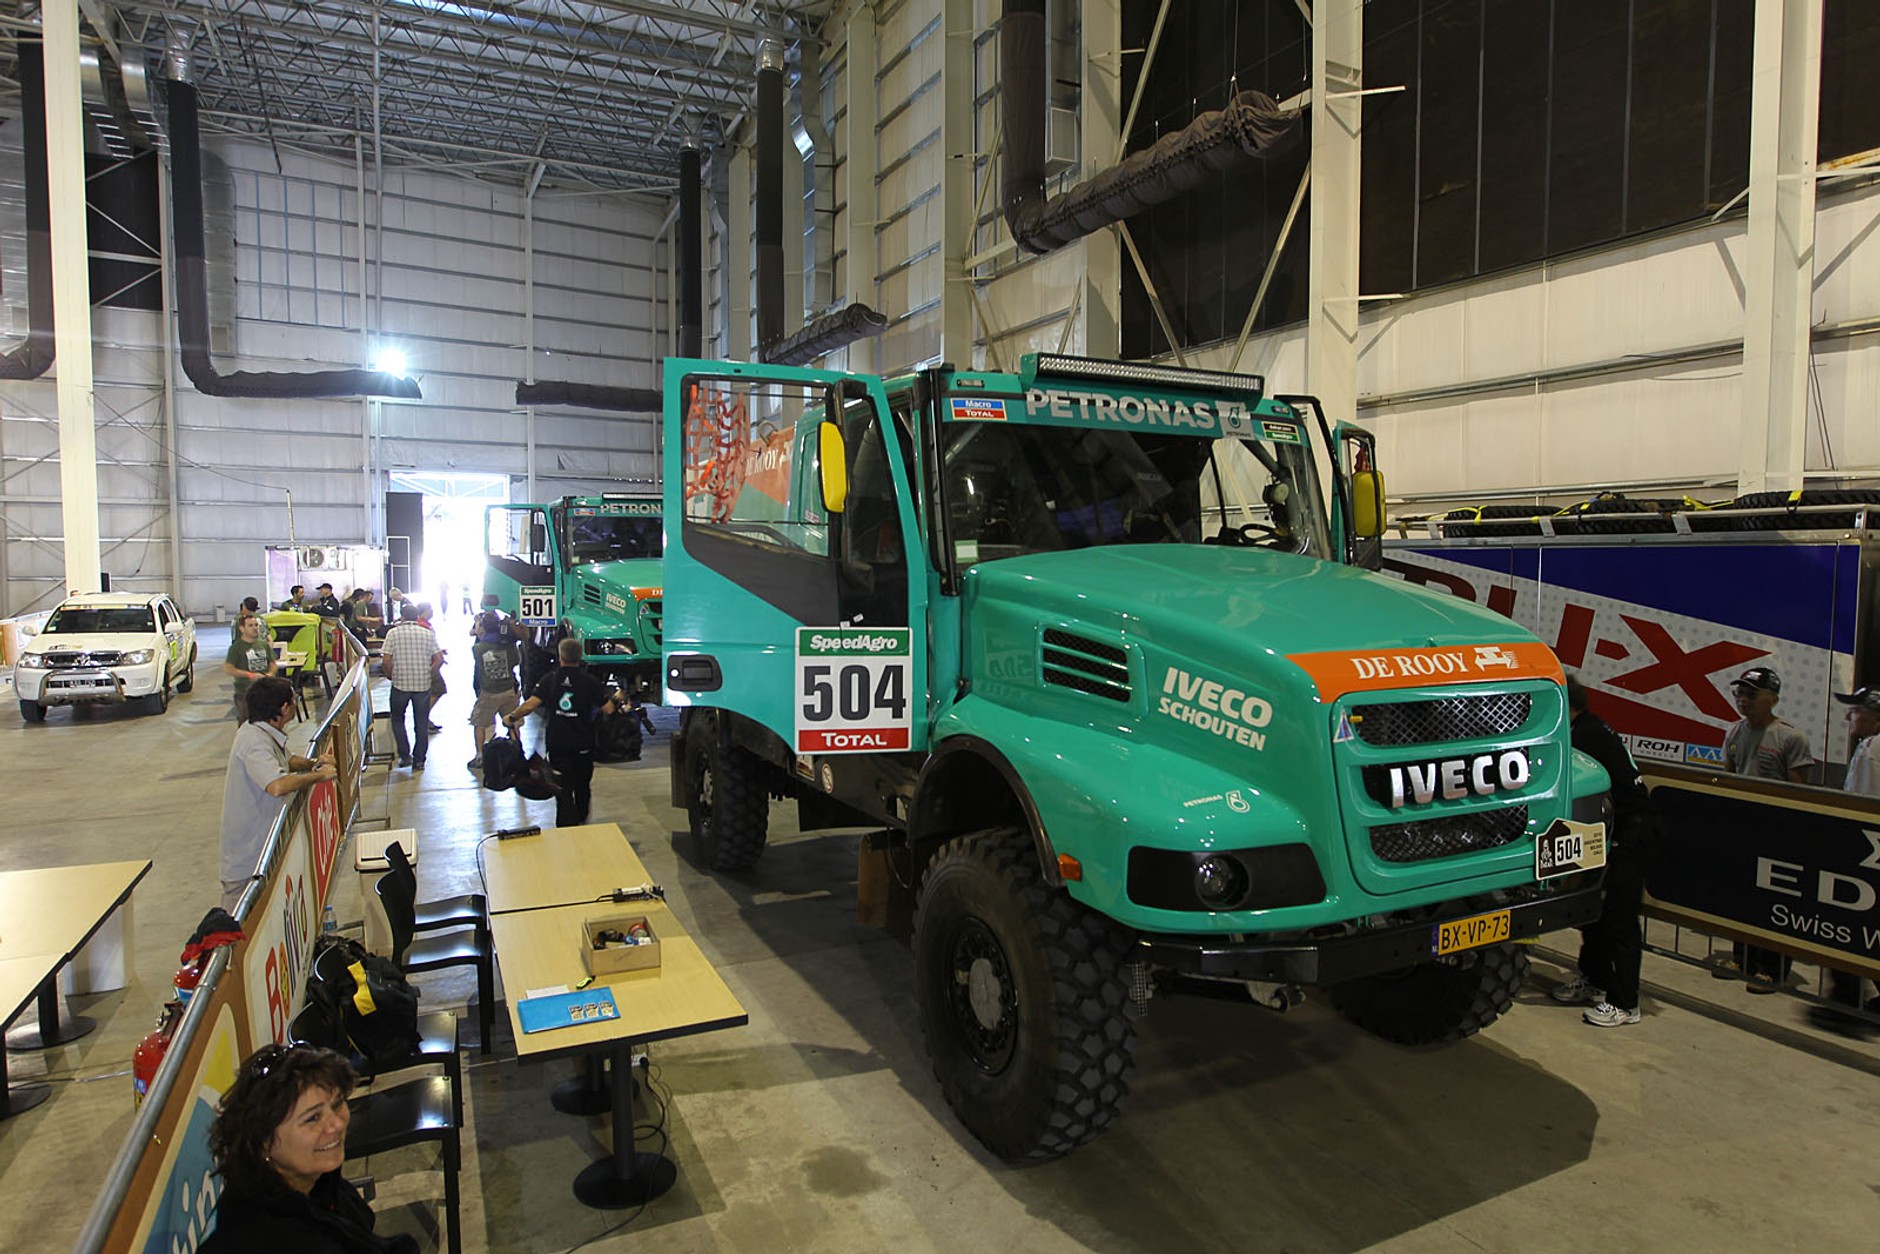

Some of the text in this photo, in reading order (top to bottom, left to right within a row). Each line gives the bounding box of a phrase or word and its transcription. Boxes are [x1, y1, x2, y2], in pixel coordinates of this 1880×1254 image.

[965, 400, 992, 409] Macro
[965, 410, 995, 418] TOTAL
[1026, 388, 1215, 430] PETRONAS
[522, 598, 553, 617] 501
[810, 634, 898, 652] SpeedAgro
[1351, 651, 1470, 680] DE ROOY
[803, 665, 907, 722] 504
[1163, 667, 1273, 728] IVECO
[1157, 697, 1267, 752] SCHOUTEN
[821, 732, 888, 747] TOTAL
[1636, 738, 1680, 754] ROH
[1389, 750, 1529, 809] IVECO
[1556, 836, 1582, 862] 504
[1441, 914, 1509, 950] BX-VP-73
[1770, 903, 1851, 944] Swiss
